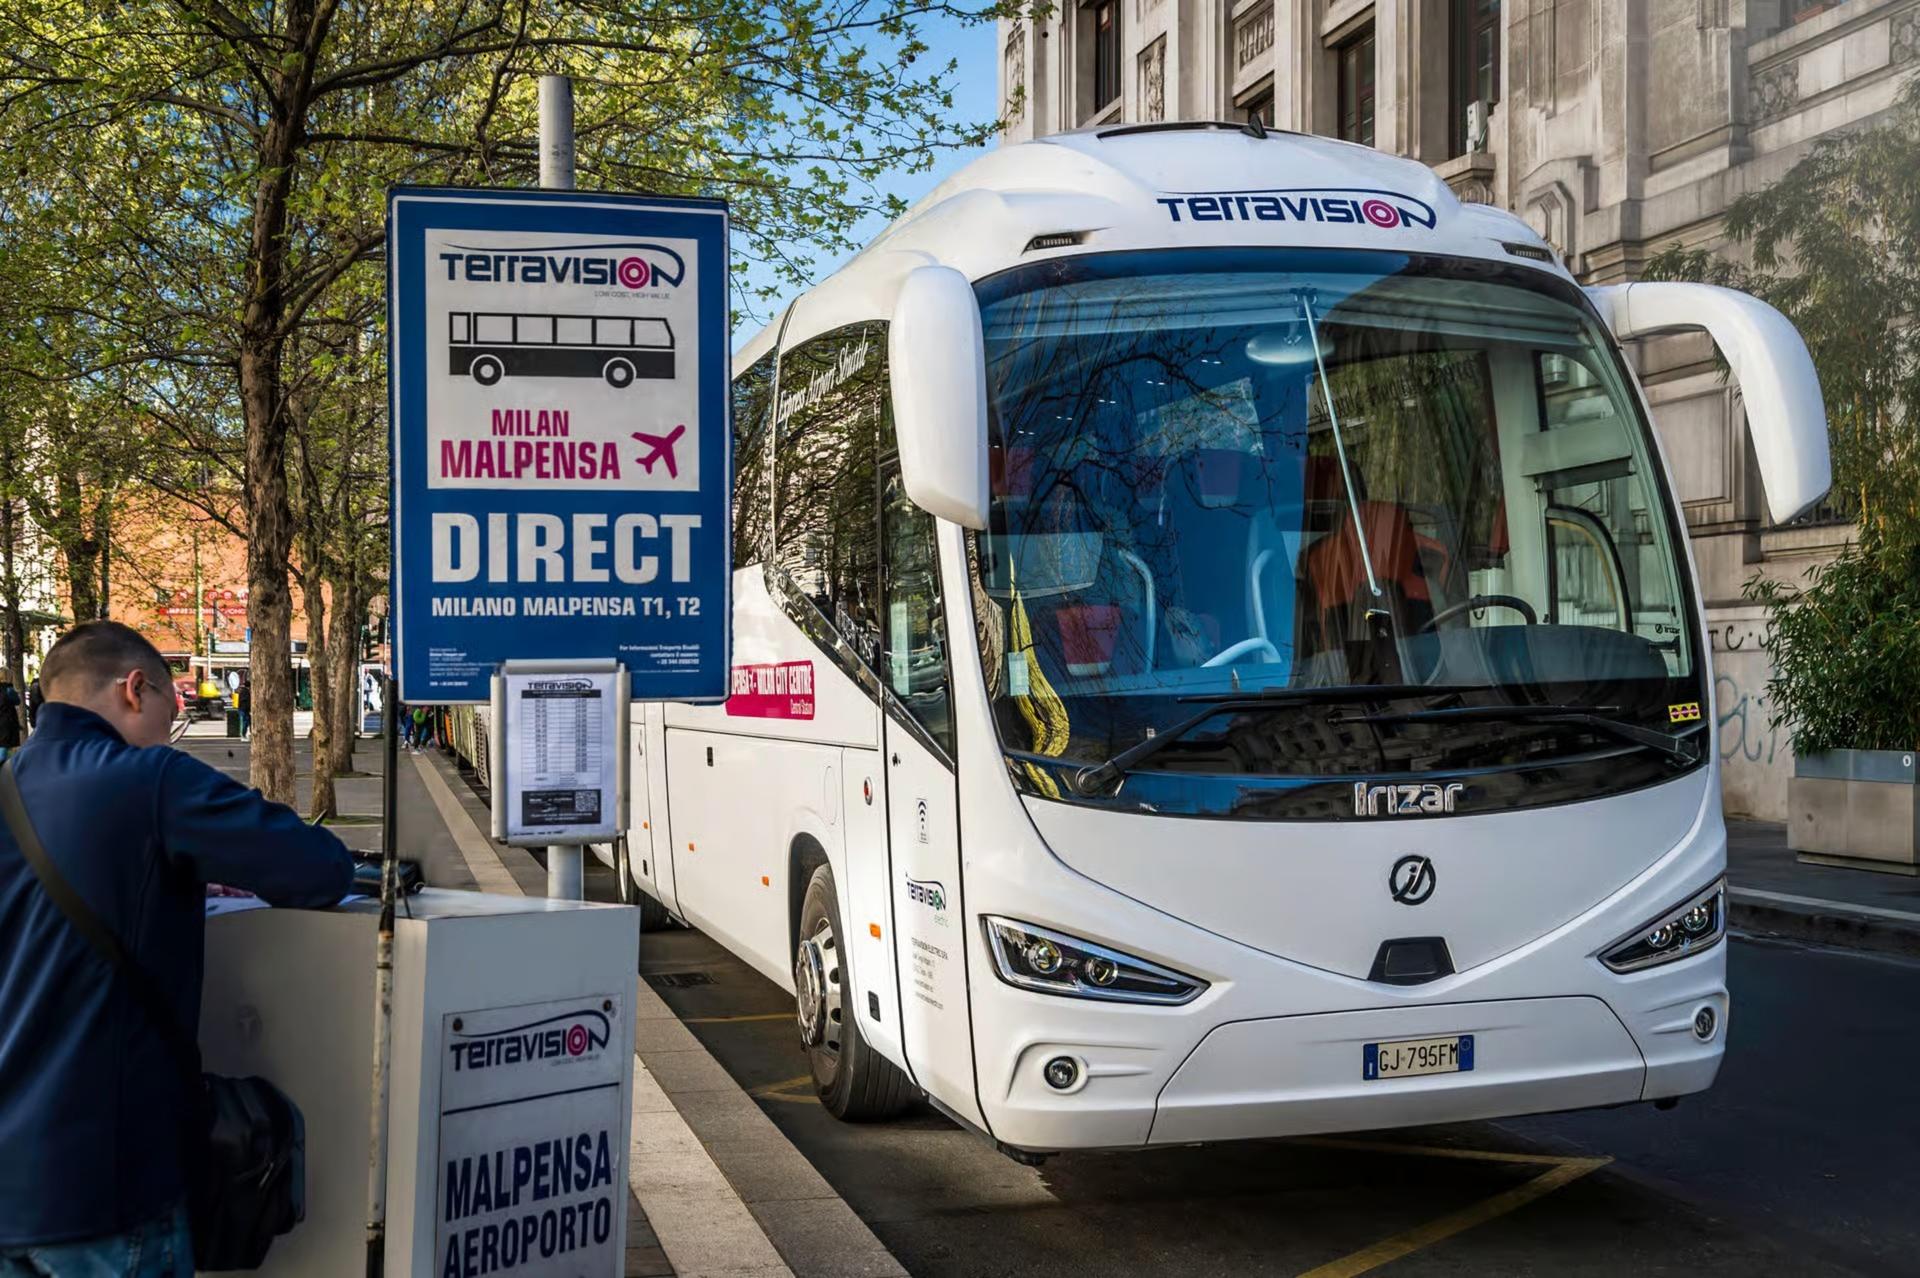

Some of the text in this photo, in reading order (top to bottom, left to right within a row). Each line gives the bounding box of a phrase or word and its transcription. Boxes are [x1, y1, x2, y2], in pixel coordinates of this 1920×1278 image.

[491, 409, 570, 437] MILAN
[441, 440, 621, 480] MALPENSA
[432, 512, 702, 584] DIRECT
[431, 597, 701, 620] MILANO MALPENSA T1, T2
[445, 1130, 612, 1223] MALPENSA
[443, 1197, 611, 1278] AEROPORTO
